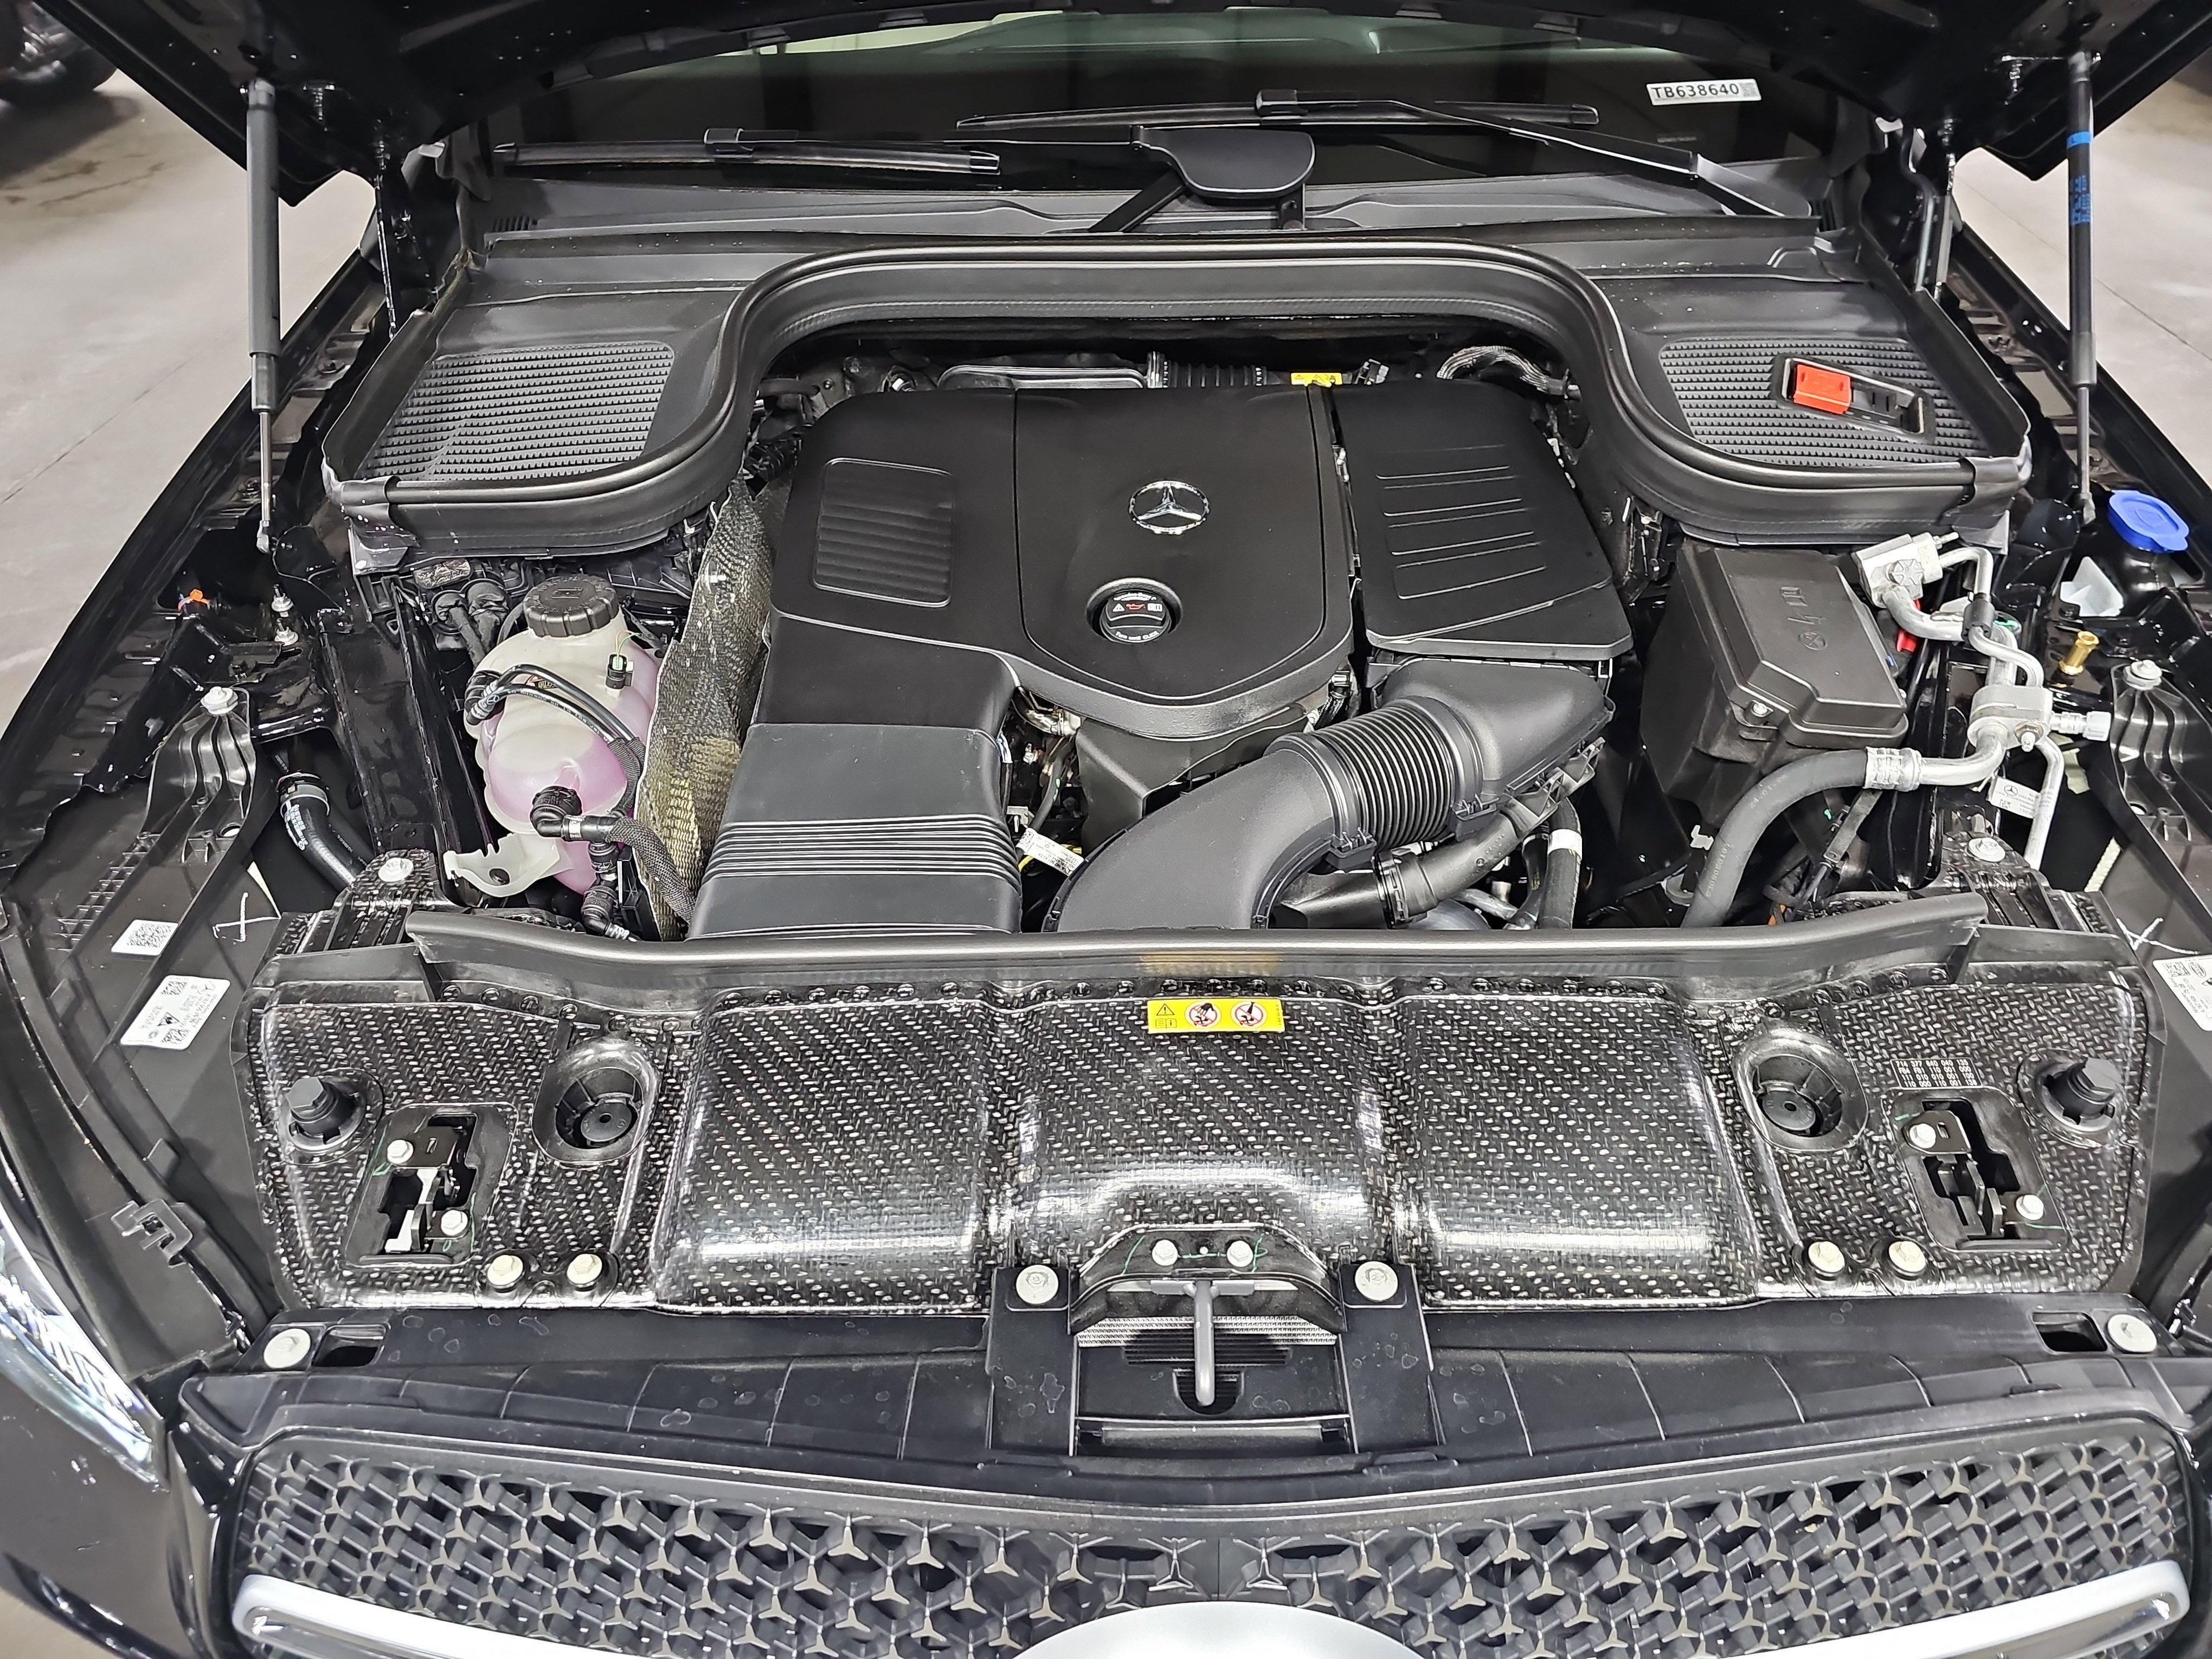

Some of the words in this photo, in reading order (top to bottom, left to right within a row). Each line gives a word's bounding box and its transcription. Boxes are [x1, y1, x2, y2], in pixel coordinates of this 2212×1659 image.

[1651, 83, 1740, 99] TB638640
[1115, 631, 1127, 639] Turn
[1142, 631, 1159, 640] CLICK
